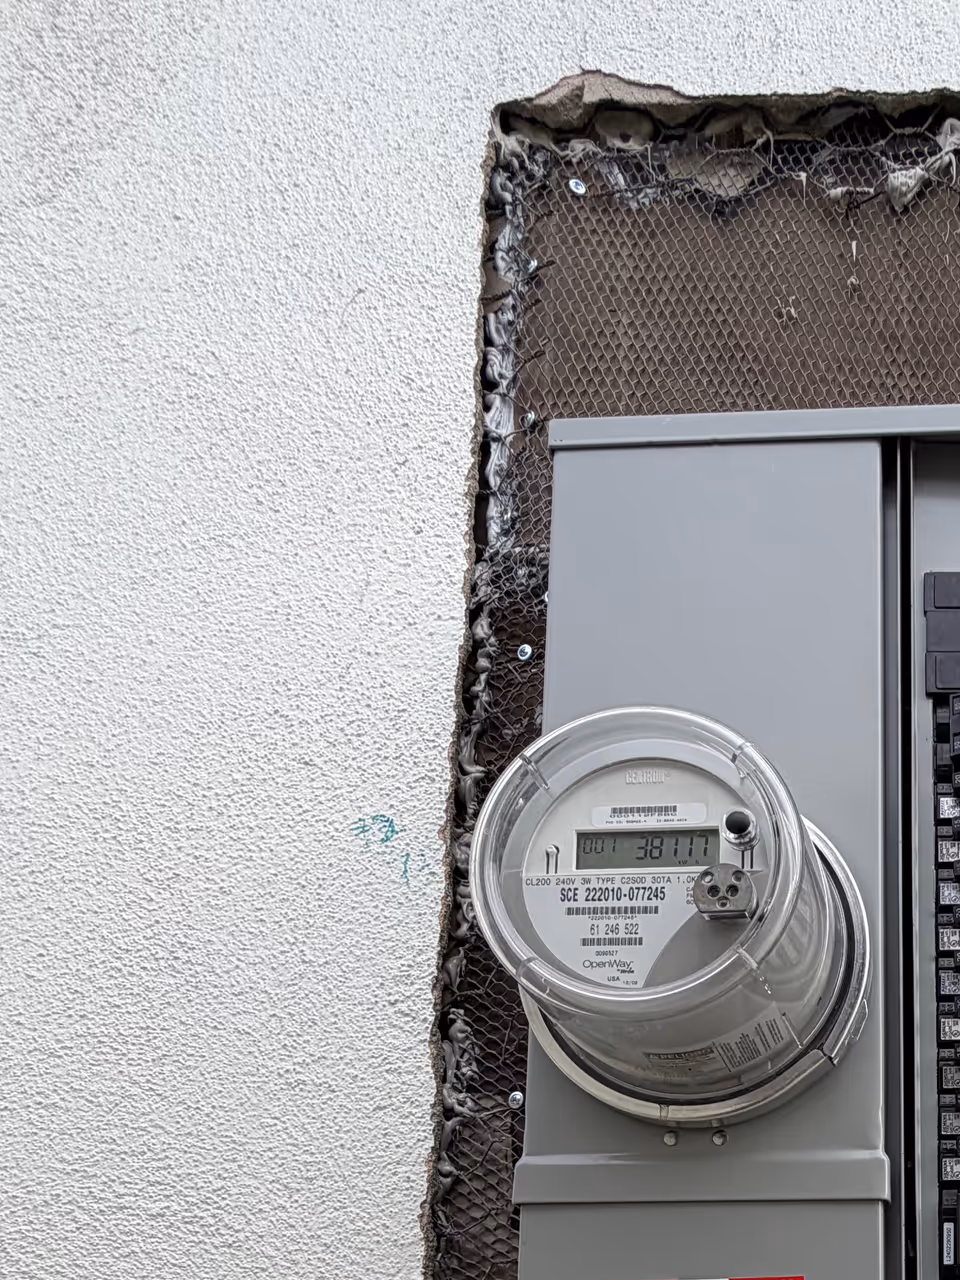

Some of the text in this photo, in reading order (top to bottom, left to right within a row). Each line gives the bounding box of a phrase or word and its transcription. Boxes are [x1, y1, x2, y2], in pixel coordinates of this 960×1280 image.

[955, 774, 960, 784] 20
[954, 819, 960, 828] 15
[582, 834, 709, 860] 001 38117
[526, 878, 551, 886] CL200
[556, 878, 576, 886] 240V
[560, 886, 666, 902] SCE 222010-077245
[590, 924, 639, 935] 61 246 522
[582, 959, 634, 969] OpenWay
